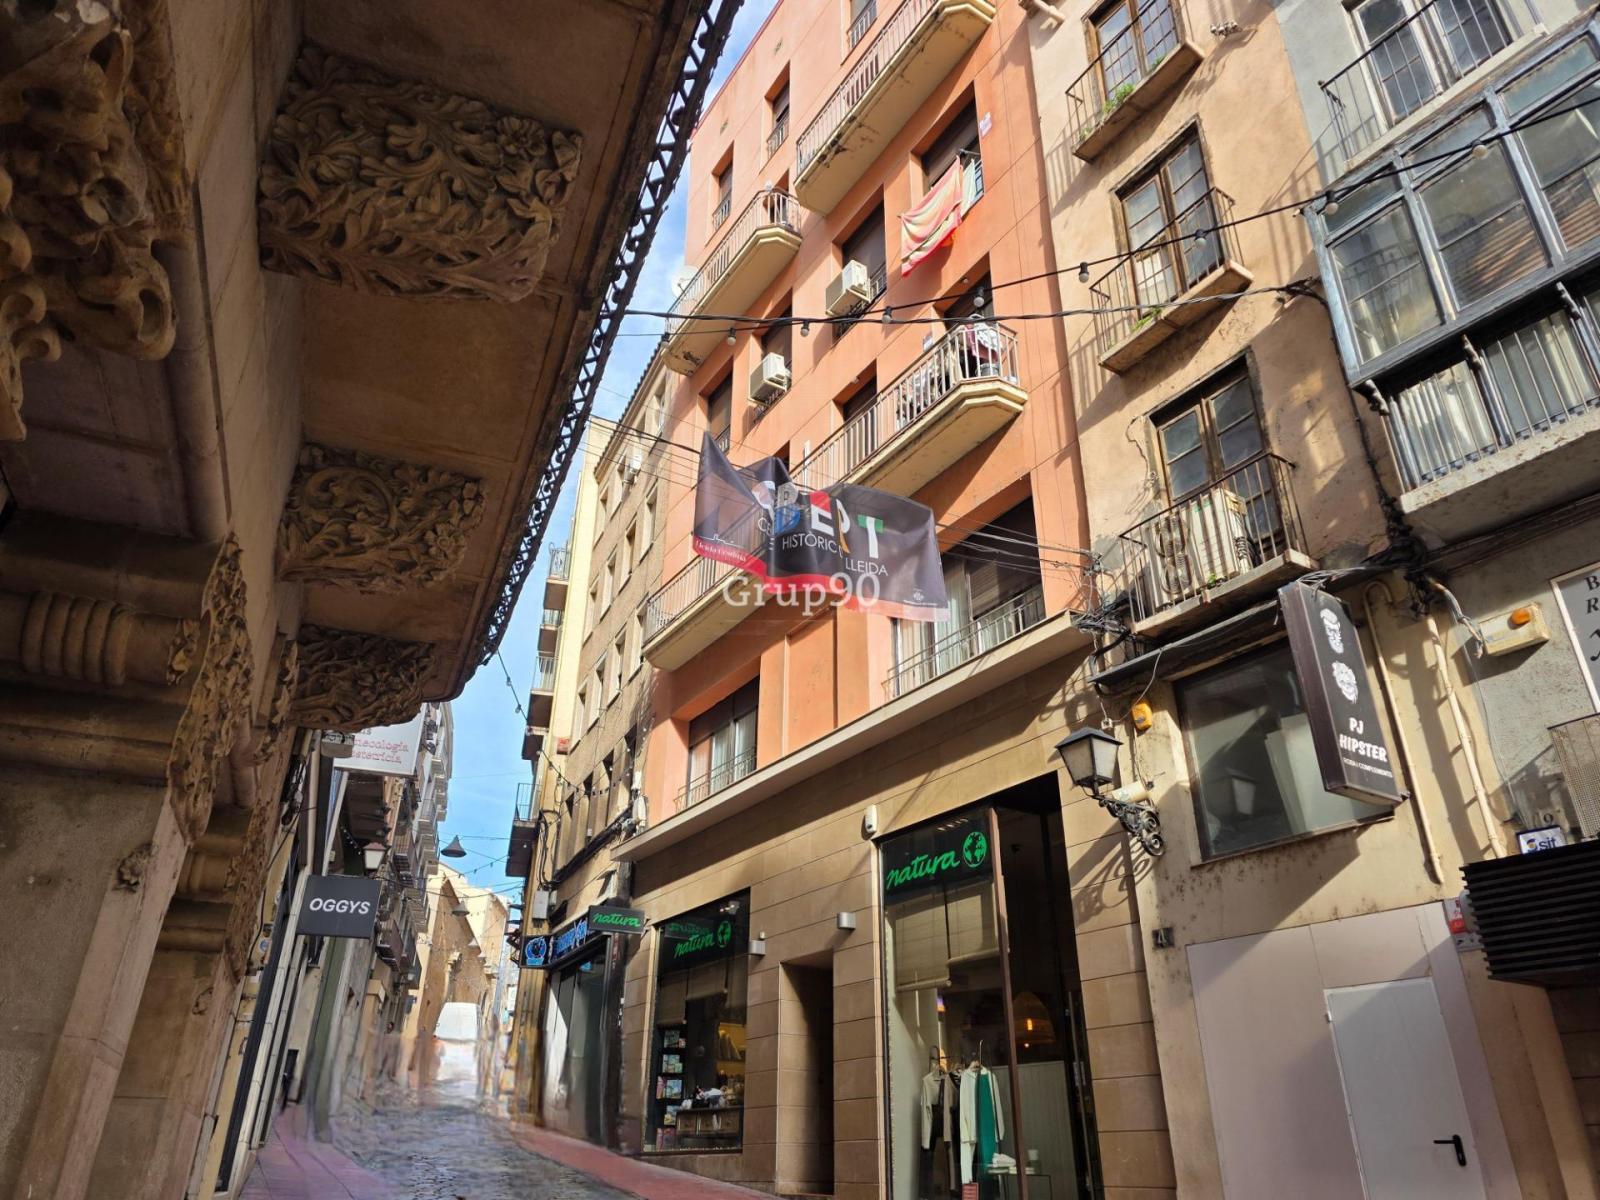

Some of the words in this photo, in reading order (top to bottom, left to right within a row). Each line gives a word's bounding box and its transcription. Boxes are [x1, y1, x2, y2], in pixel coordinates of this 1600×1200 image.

[782, 530, 838, 554] HISTÒRIC
[845, 557, 889, 577] LLEIDA
[1349, 717, 1364, 734] PJ
[1340, 734, 1387, 762] HIPSTER
[885, 850, 961, 890] natura
[309, 897, 371, 915] OGGYS
[593, 912, 641, 928] natura
[673, 932, 716, 959] natura
